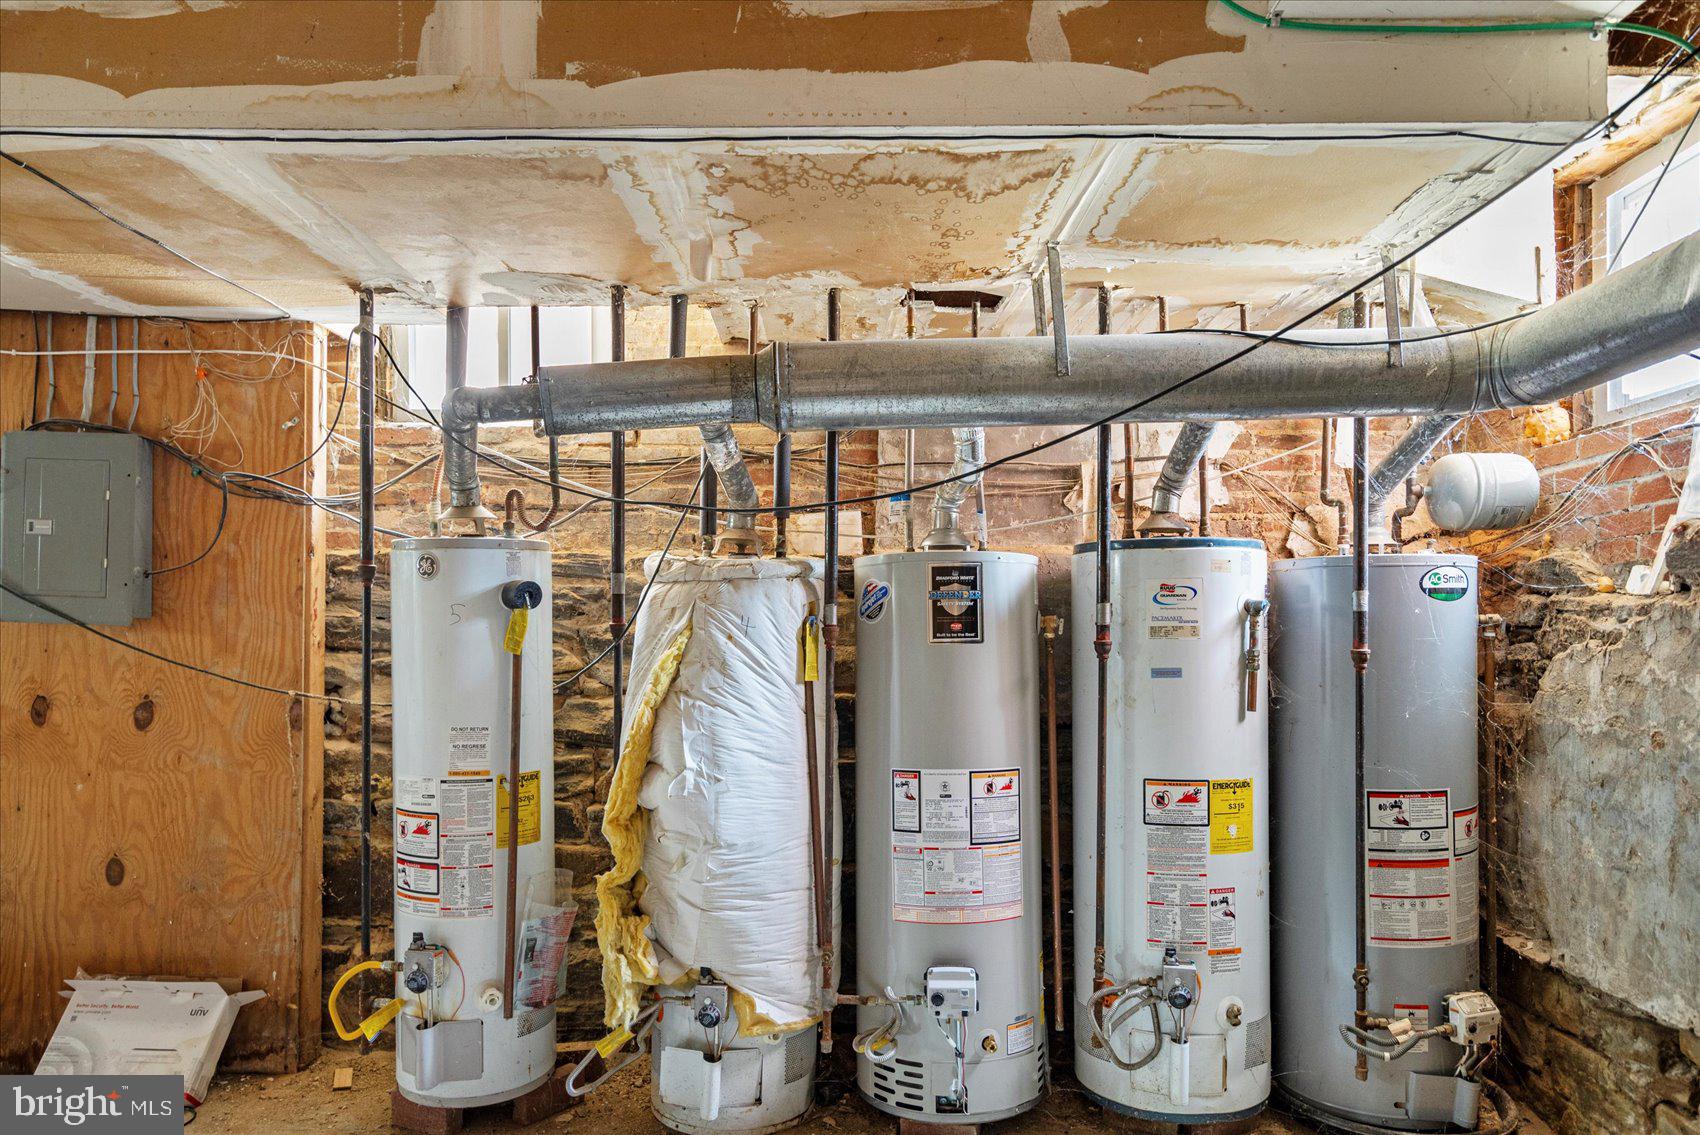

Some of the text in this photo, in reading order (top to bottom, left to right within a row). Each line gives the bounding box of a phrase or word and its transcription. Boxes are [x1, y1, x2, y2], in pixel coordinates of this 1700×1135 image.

[1443, 573, 1465, 584] Smith
[930, 591, 981, 599] DEFENDER
[450, 604, 466, 625] 5
[740, 614, 756, 637] 4
